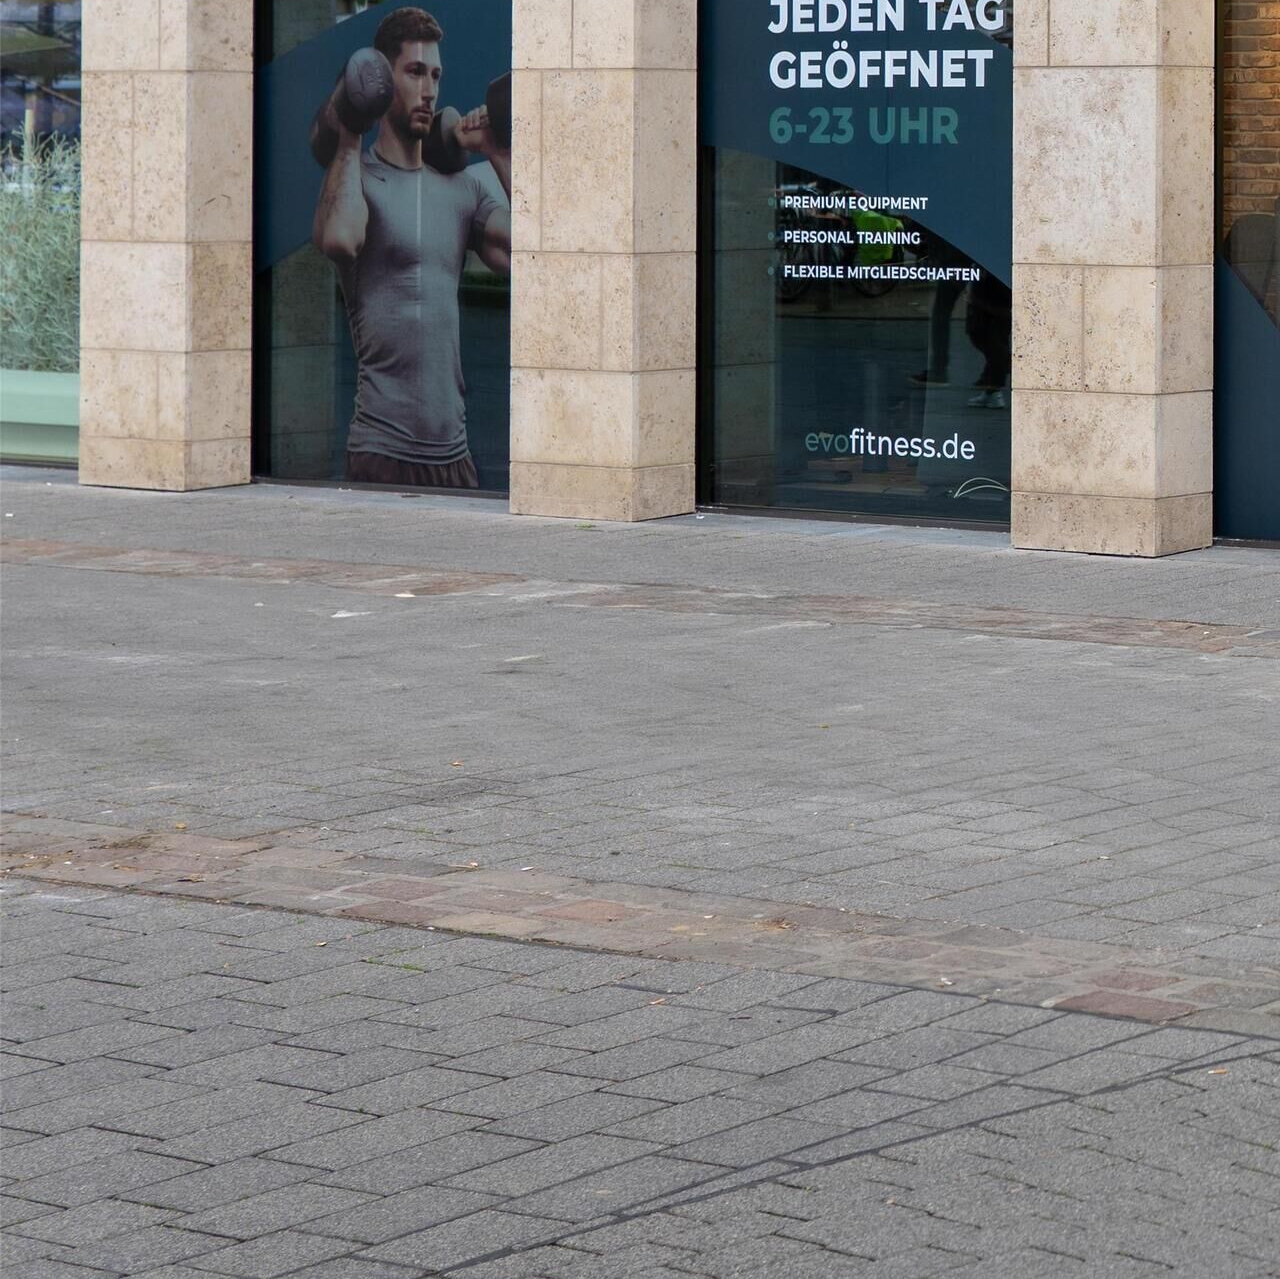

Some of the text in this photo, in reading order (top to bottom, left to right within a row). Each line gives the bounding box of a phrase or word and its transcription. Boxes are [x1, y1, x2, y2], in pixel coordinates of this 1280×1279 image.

[769, 40, 994, 89] GEÖFFNET
[769, 106, 959, 145] 6-23 UHR
[784, 196, 928, 212] PREMIUM EQUIPMENT
[784, 231, 921, 245] PERSONAL TRAINING
[784, 266, 980, 281] FLEXIBLE MITGLIEDSCHAFTEN
[805, 428, 976, 459] evofitness.de
